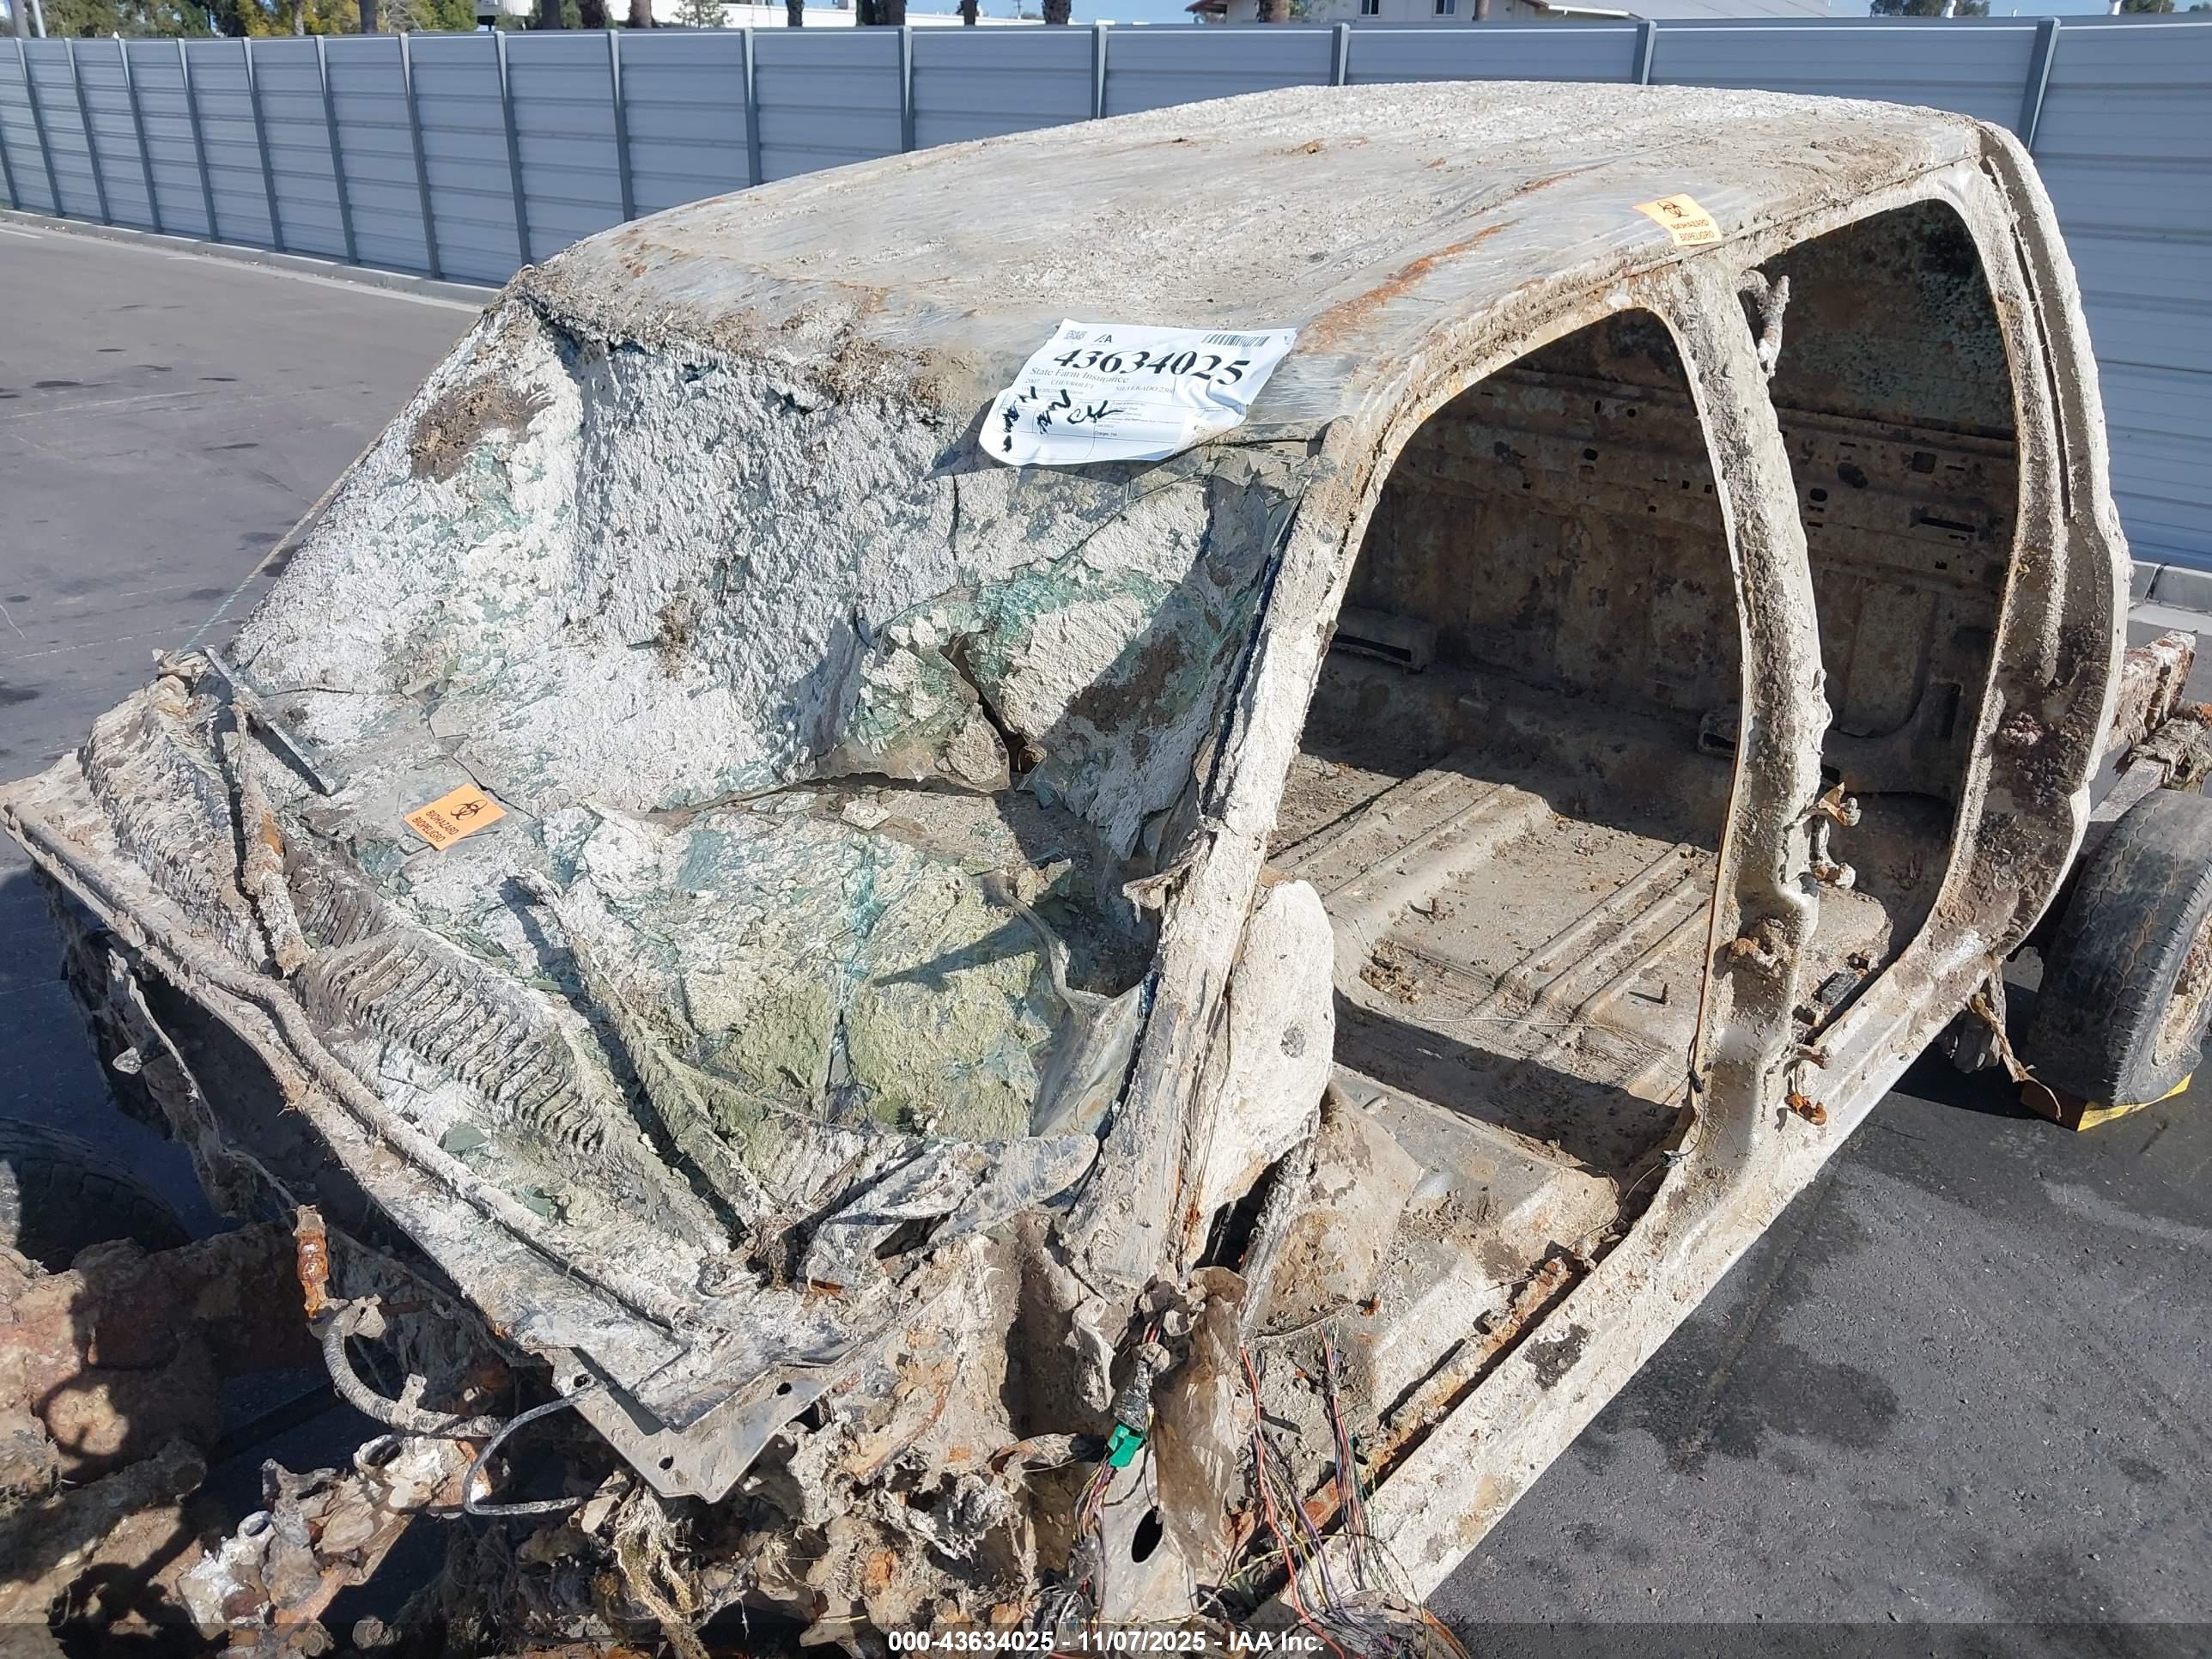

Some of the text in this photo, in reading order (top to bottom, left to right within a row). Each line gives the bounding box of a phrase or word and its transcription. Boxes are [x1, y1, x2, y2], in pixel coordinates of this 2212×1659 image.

[1030, 367, 1129, 384] State Farm Insurance
[1053, 348, 1251, 386] 43634025
[412, 816, 447, 842] BIOPELIGRO
[426, 809, 459, 836] BIOHAZARD
